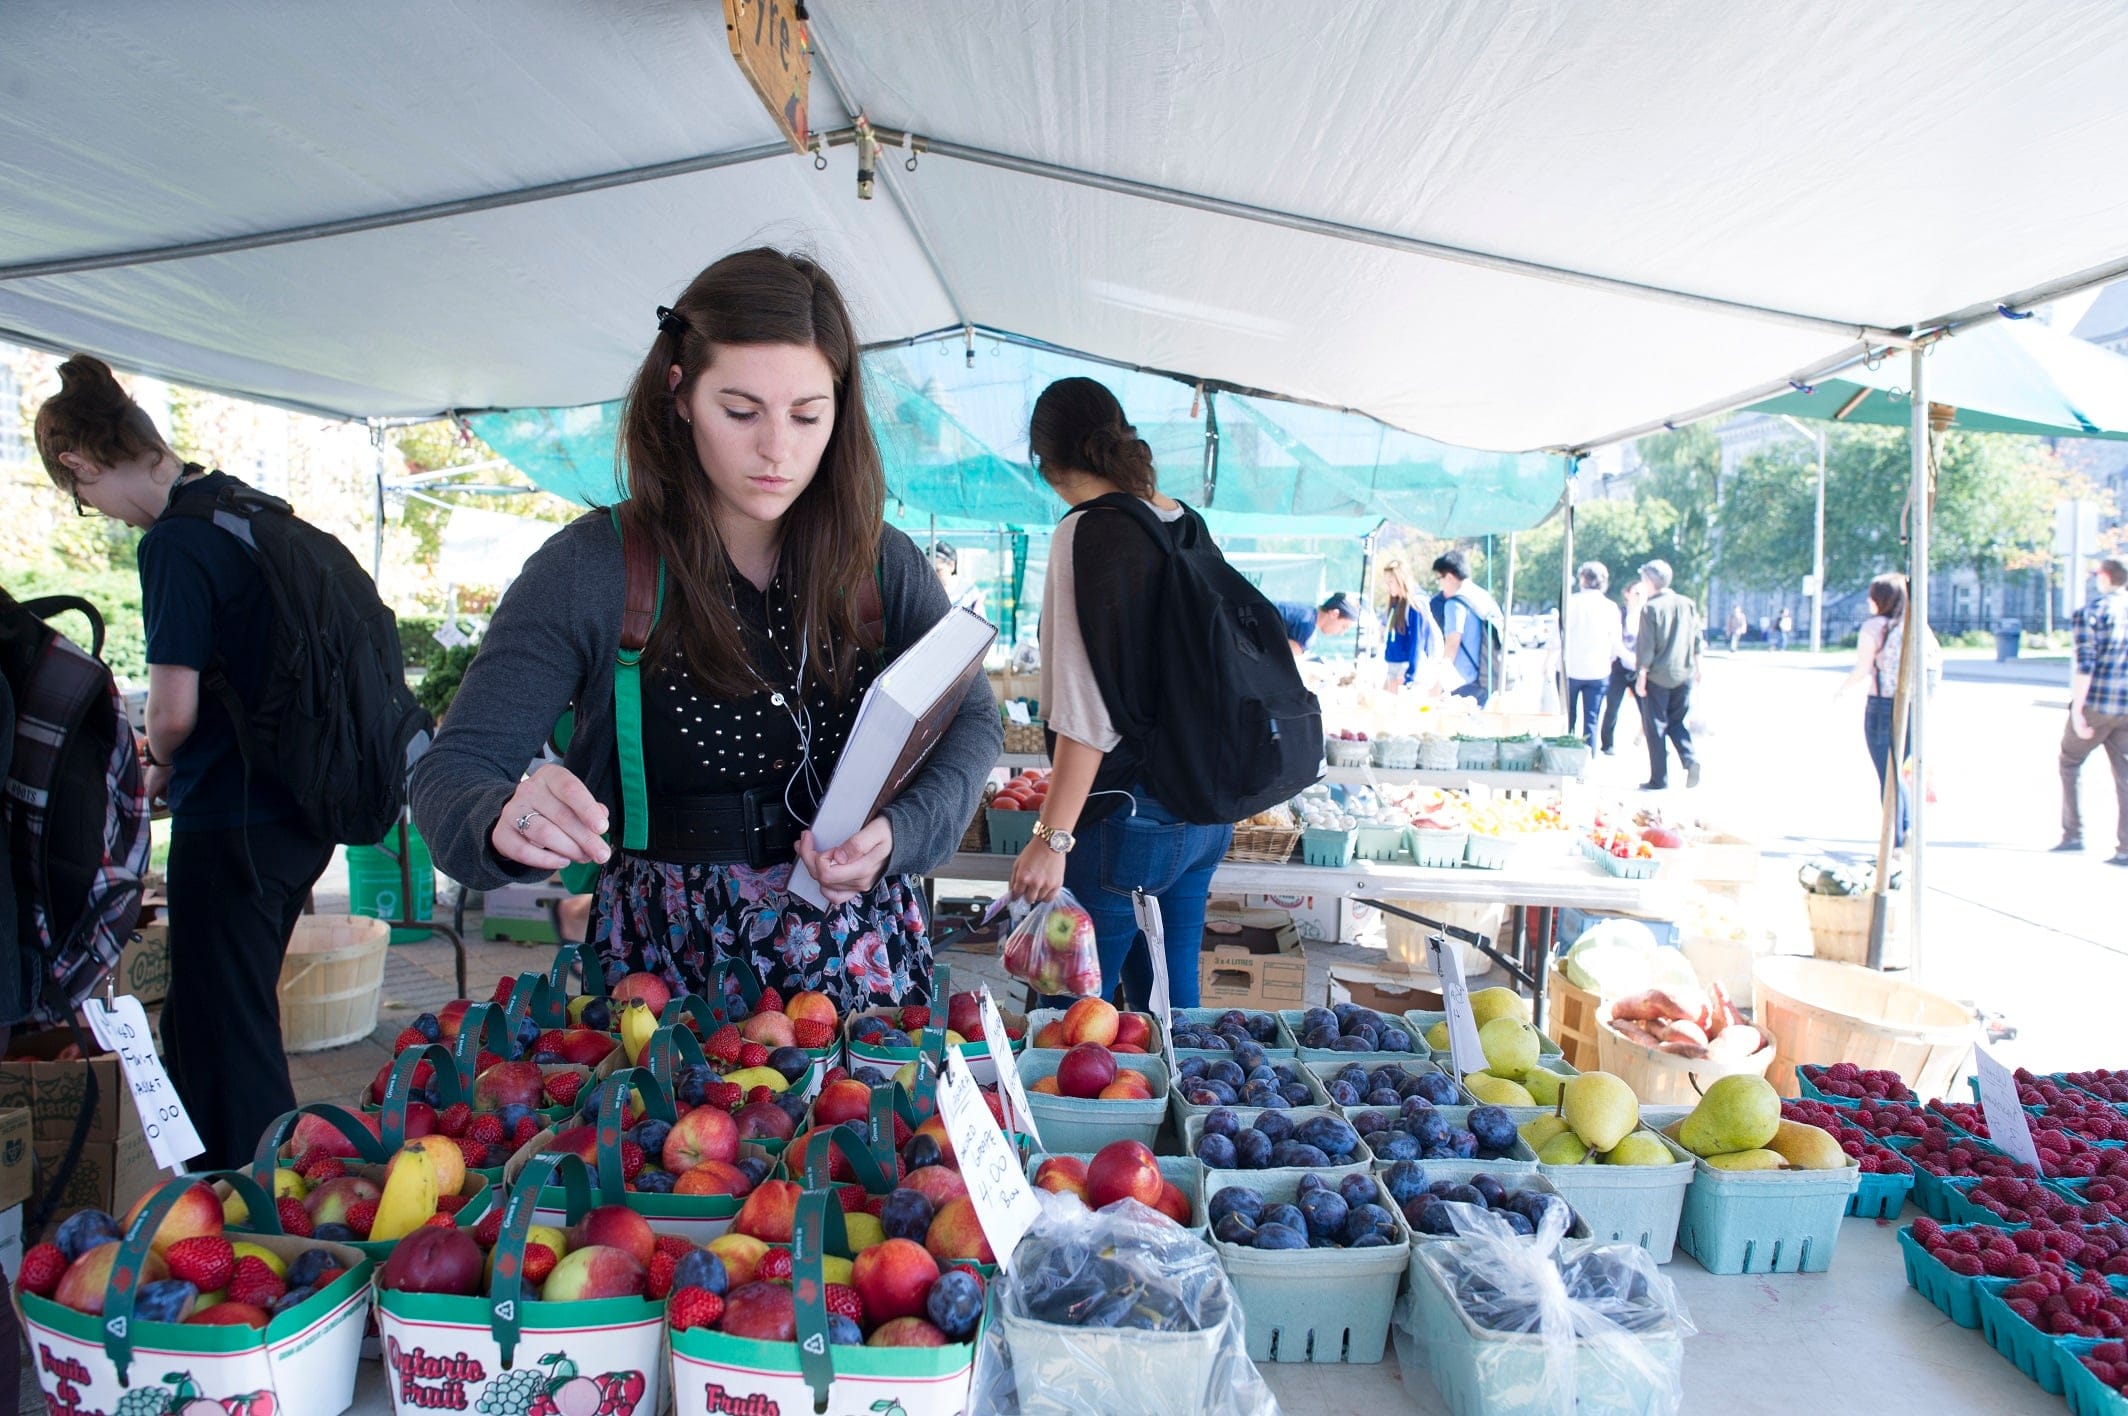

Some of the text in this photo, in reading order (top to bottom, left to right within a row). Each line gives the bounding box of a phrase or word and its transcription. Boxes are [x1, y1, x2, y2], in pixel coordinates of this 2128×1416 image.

[38, 1341, 92, 1387] Fruits
[387, 1335, 486, 1383] Ontario
[400, 1375, 469, 1411] Fruit
[705, 1383, 780, 1416] Fruits
